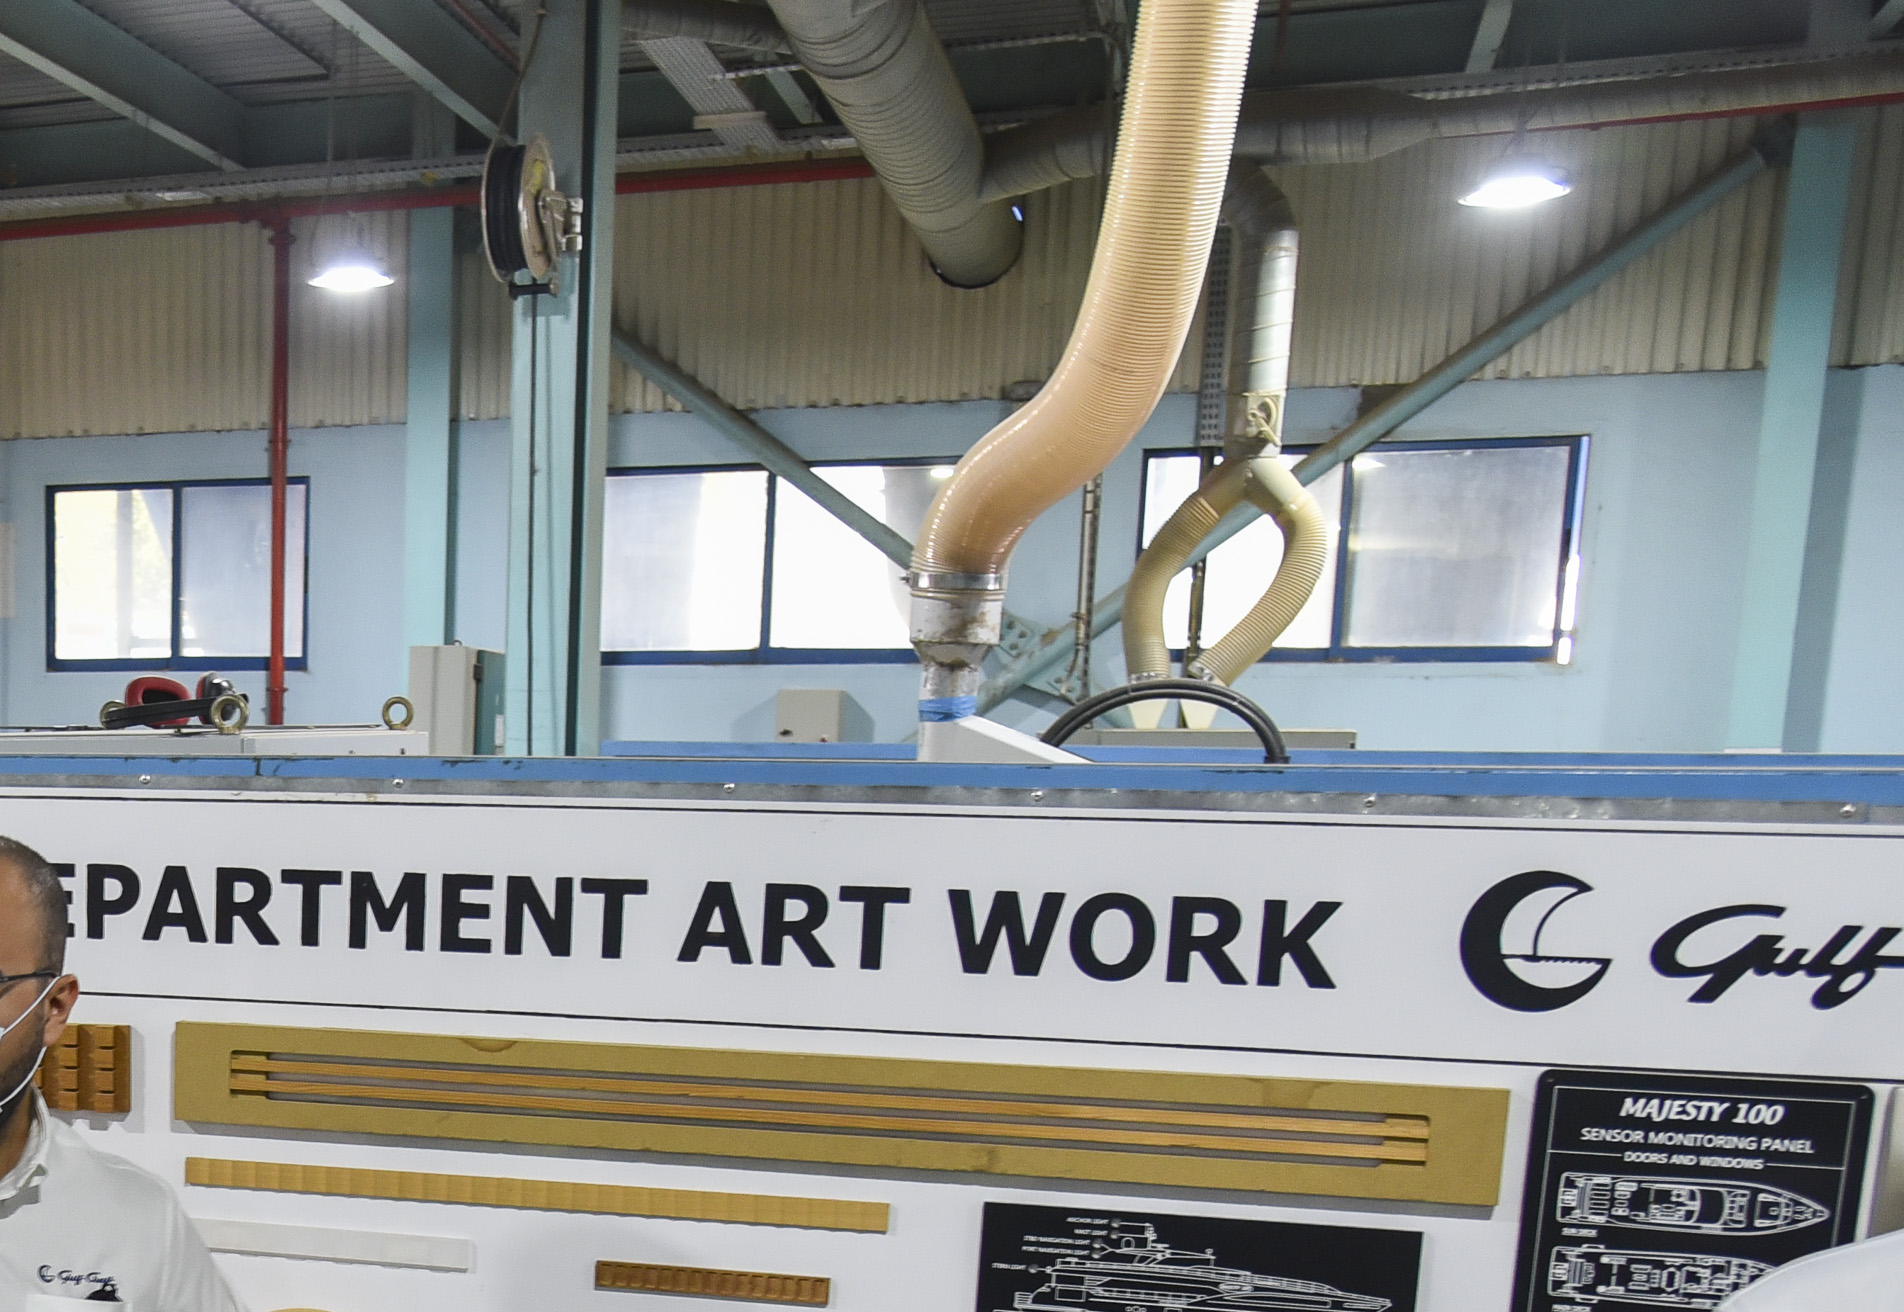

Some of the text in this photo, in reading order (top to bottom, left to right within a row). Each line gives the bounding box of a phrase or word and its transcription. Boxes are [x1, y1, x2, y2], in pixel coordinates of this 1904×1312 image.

[47, 862, 649, 960] PARTMENT
[677, 880, 911, 972] ART
[947, 889, 1344, 990] WORK
[1649, 903, 1904, 1011] Gulf
[1619, 1097, 1785, 1125] MAJESTY 100
[1580, 1127, 1815, 1153] SENSOR MONITORING PANEL
[1623, 1151, 1765, 1169] DOORS AND WINDOWS
